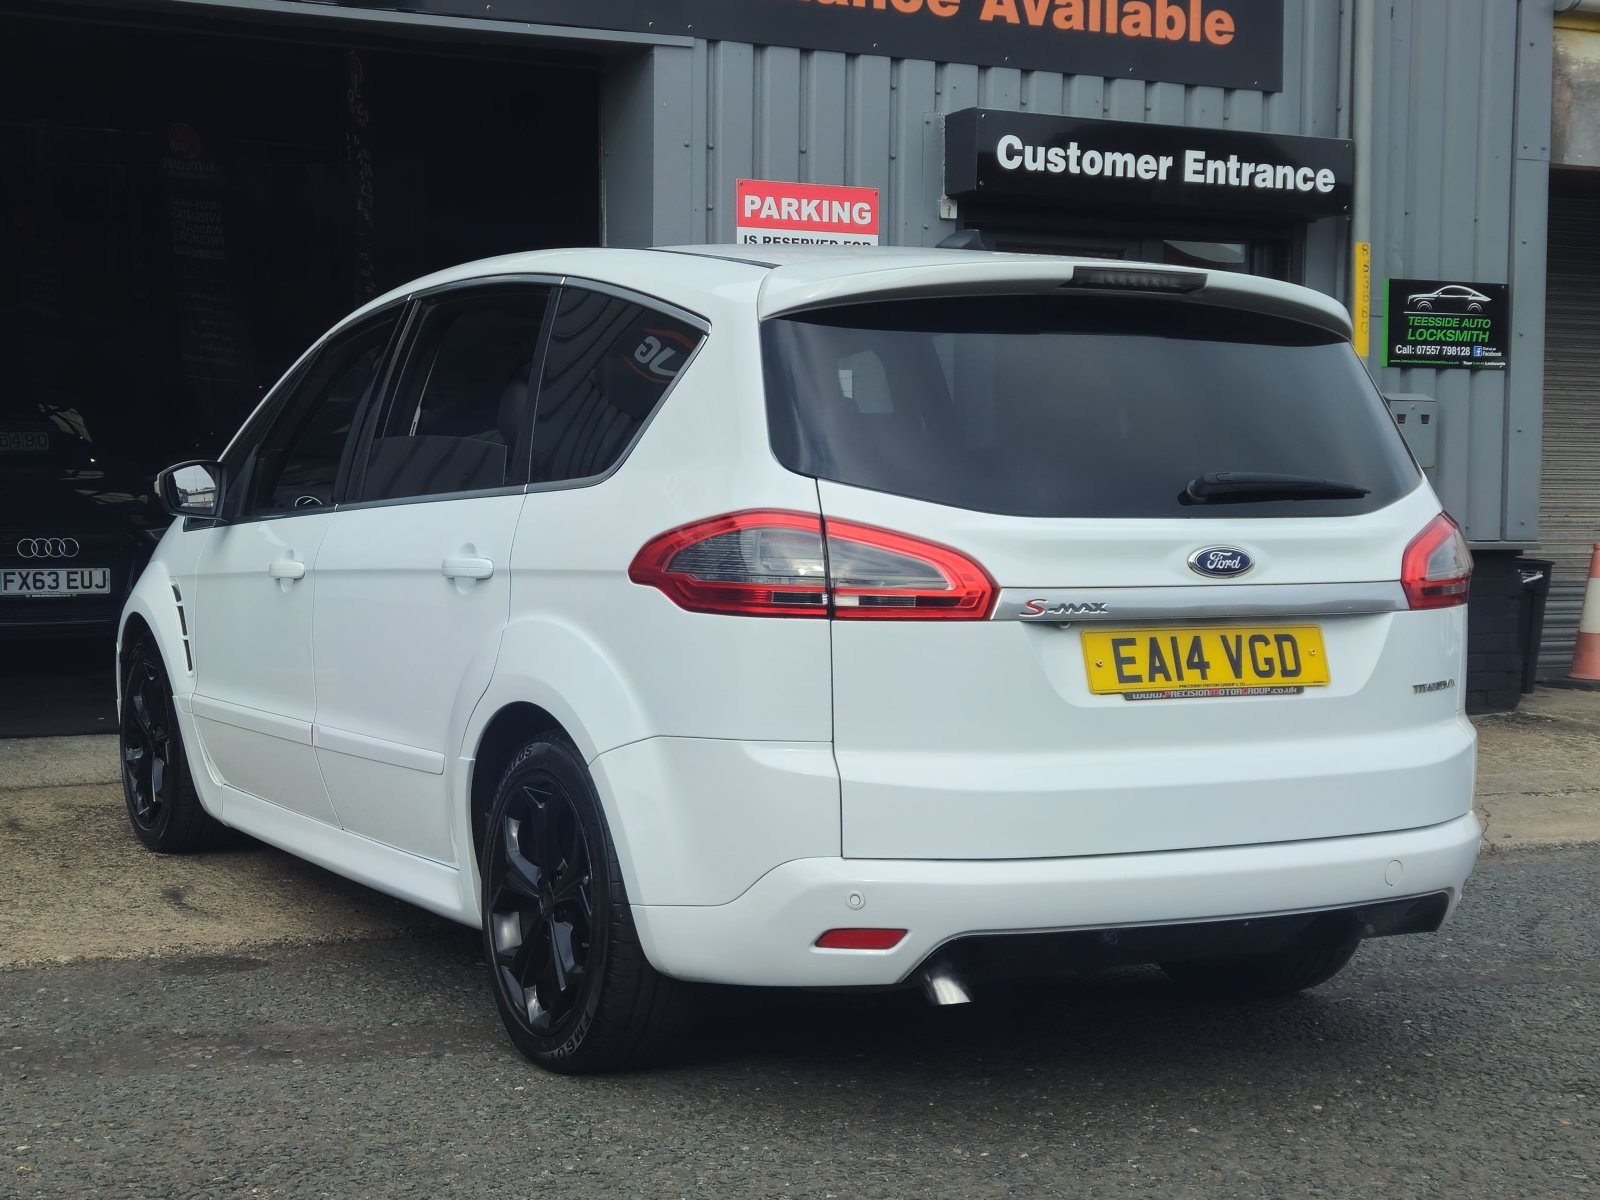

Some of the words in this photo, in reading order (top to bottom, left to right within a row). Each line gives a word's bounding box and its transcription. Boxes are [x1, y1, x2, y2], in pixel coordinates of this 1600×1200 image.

[996, 134, 1173, 180] Customer
[1184, 149, 1335, 193] Entrance
[744, 194, 872, 225] PARKING
[1408, 316, 1460, 328] TEESSIDE
[1462, 318, 1492, 328] AUTO
[1407, 329, 1490, 342] LOCKSMITH
[1395, 344, 1415, 354] Call:
[1416, 345, 1440, 355] 07557
[1442, 346, 1471, 356] 798128
[1207, 551, 1241, 570] Ford
[3, 571, 60, 590] FX63
[66, 570, 107, 589] EUJ
[1018, 598, 1109, 618] S-MAX
[1111, 635, 1211, 684] EA14
[1219, 633, 1302, 680] VGD
